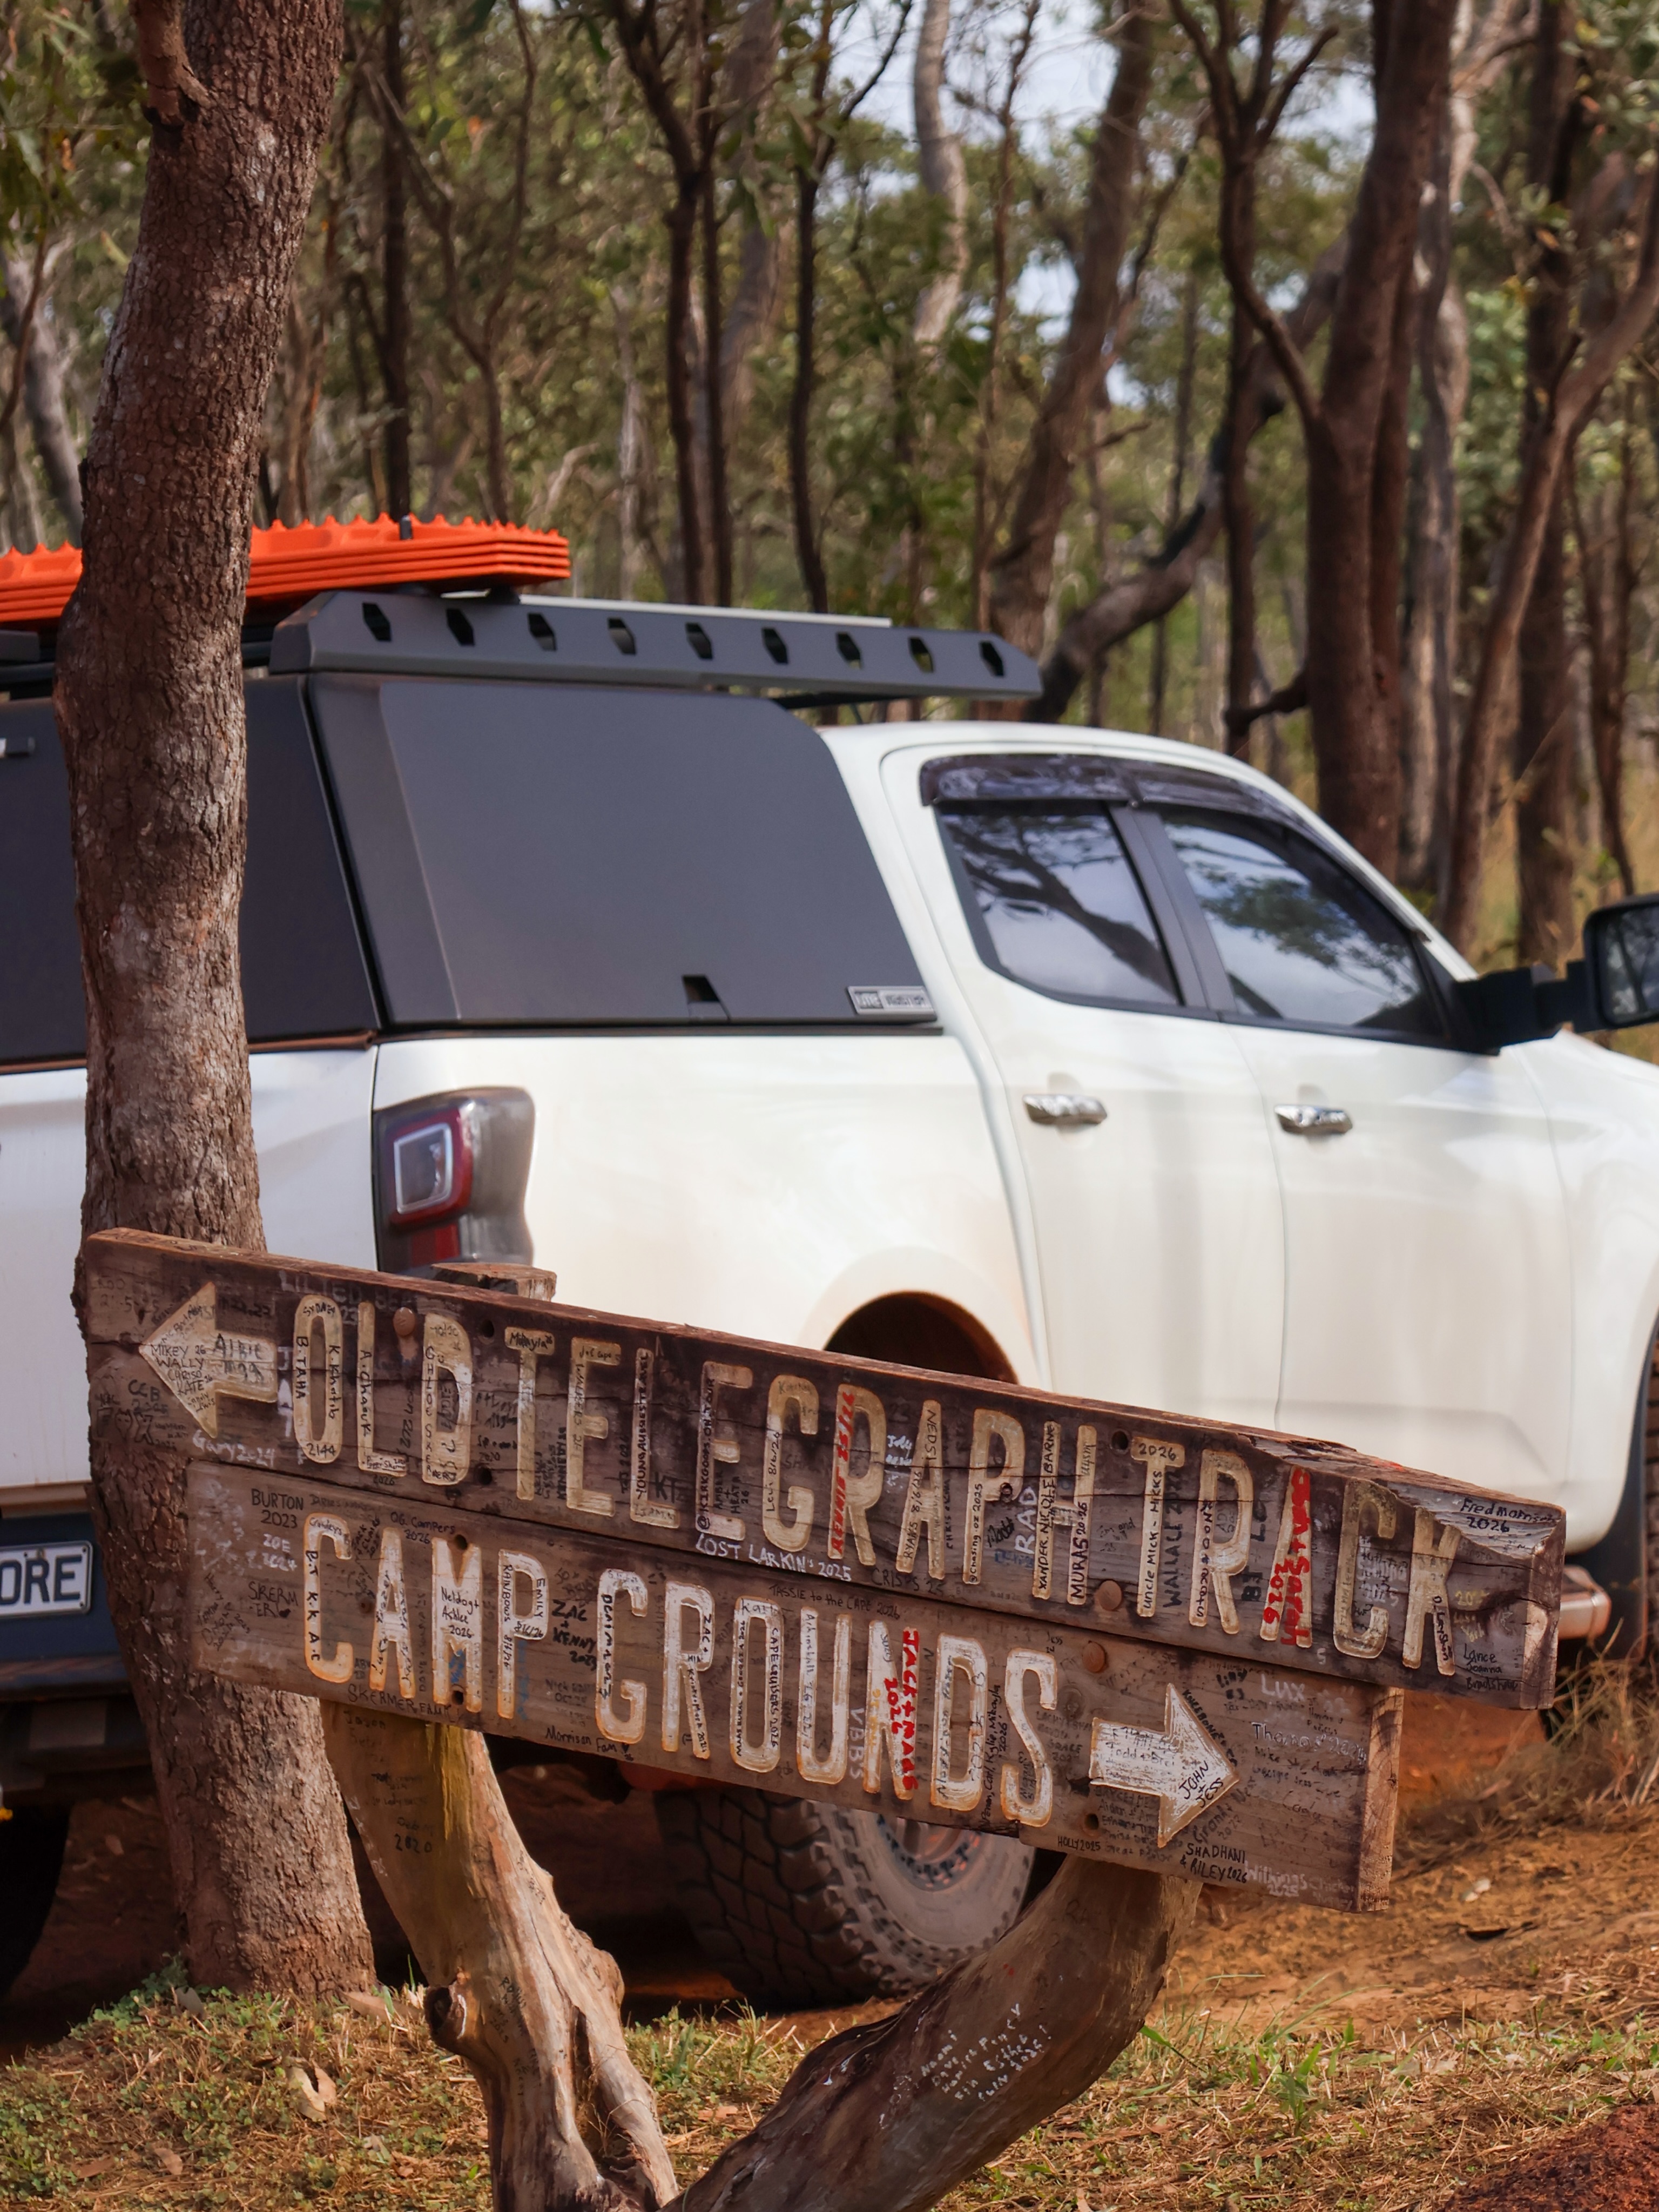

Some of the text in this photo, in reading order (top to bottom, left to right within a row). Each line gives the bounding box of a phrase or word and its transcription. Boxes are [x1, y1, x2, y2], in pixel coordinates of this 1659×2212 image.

[151, 1344, 188, 1357] MIKEY
[155, 1358, 204, 1369] WALLY
[306, 1442, 336, 1456] 2144
[1138, 1442, 1177, 1460] 2026
[293, 1294, 473, 1486] OLD
[504, 1326, 1097, 1605] TELEGRAPH
[1130, 1435, 1460, 1676] TRACK
[251, 1488, 304, 1511] BURTON
[1460, 1498, 1494, 1515] Fred
[260, 1510, 297, 1529] 2023
[1015, 1486, 1037, 1555] RAD
[1466, 1516, 1510, 1533] 2026
[262, 1533, 291, 1553] ZOE
[696, 1533, 852, 1582] LOST 2025
[502, 1564, 513, 1622] RAINBOWS
[536, 1577, 546, 1618] EMILY
[770, 1583, 807, 1600] TASSIE
[810, 1590, 822, 1602] to
[825, 1592, 844, 1607] the
[876, 1601, 901, 1620] 2026
[551, 1599, 588, 1621] ZAC
[552, 1628, 595, 1654] KENNY
[1463, 1643, 1496, 1664] Lance
[304, 1513, 549, 1719] CAMP
[595, 1568, 1057, 1827] GROUNDS
[884, 1677, 903, 1735] 2026
[769, 1717, 780, 1748] 2026
[1178, 1761, 1210, 1800] JOHN
[1195, 1777, 1224, 1809] JESS
[1185, 1842, 1246, 1864] SHADHANI
[1190, 1858, 1226, 1882] RILEY
[1226, 1866, 1247, 1884] 2026
